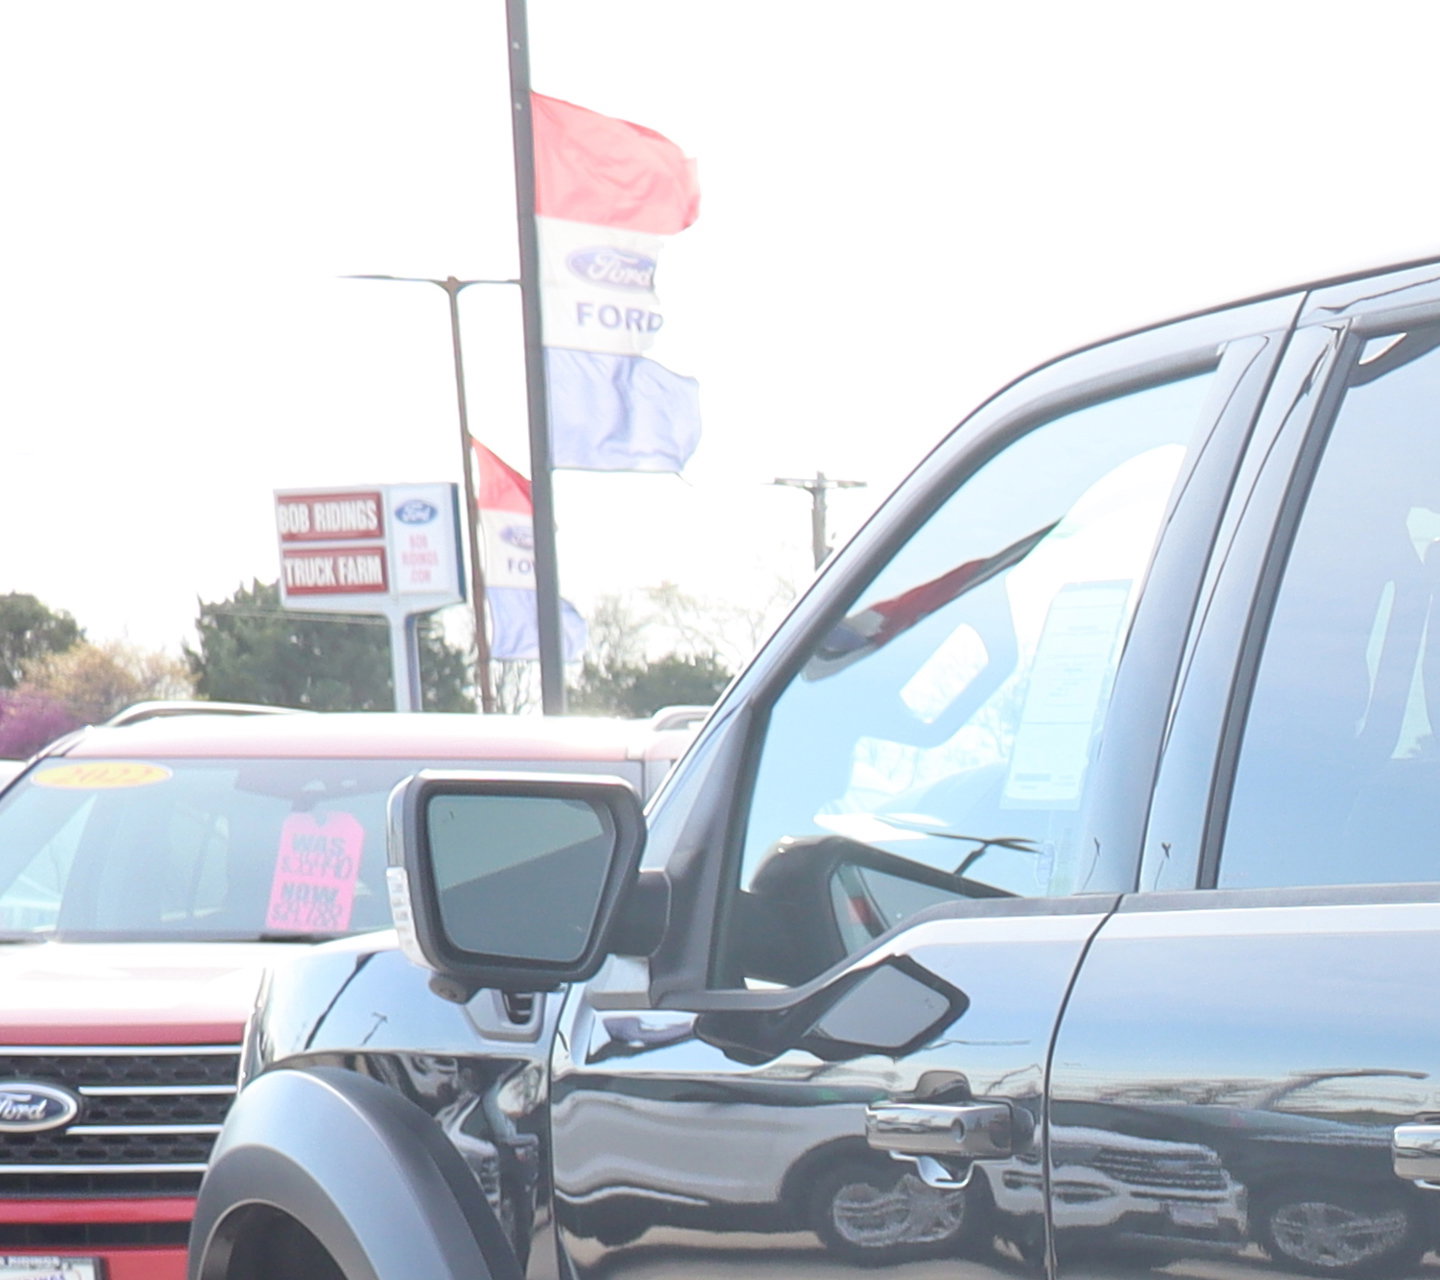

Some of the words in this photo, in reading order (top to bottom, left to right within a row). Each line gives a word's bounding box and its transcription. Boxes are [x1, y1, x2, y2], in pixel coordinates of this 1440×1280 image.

[575, 301, 664, 333] FORD
[278, 502, 310, 535] BOB
[313, 499, 377, 533] RIDINGS
[285, 557, 336, 588] TRUCK
[338, 554, 382, 585] FARM
[291, 833, 346, 857] WAS
[283, 882, 340, 904] NOW
